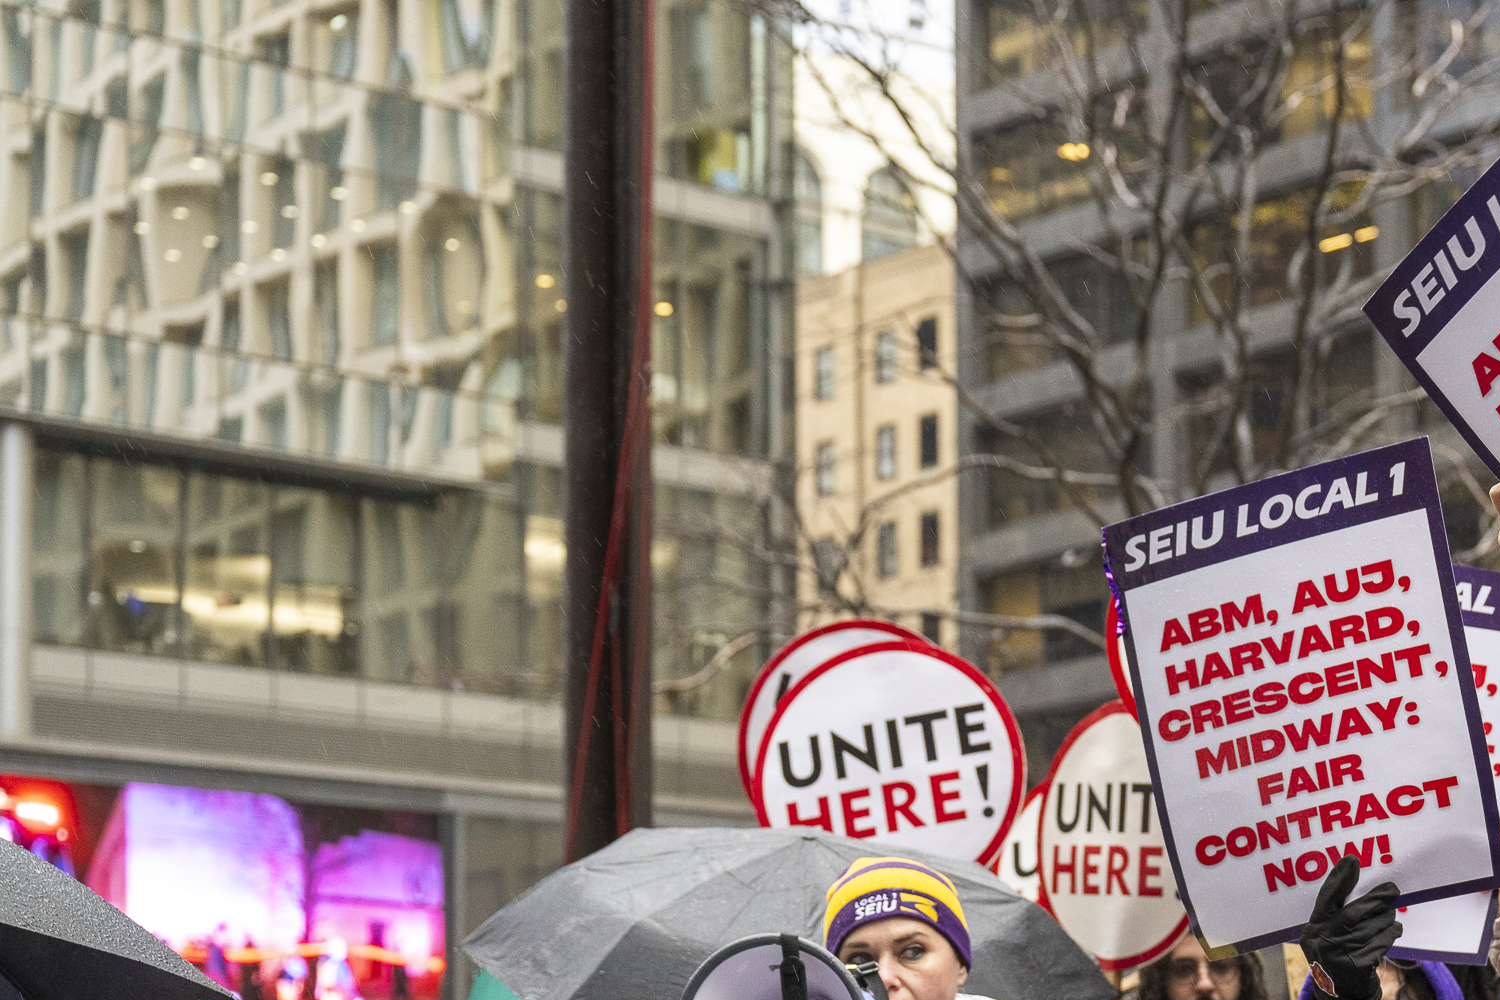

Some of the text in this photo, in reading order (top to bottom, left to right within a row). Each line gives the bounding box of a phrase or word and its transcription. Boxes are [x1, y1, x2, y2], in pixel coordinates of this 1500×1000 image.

[1392, 225, 1487, 337] SEIU
[1124, 461, 1407, 574] SEIU LOCAL 1
[1159, 592, 1278, 653] ABM,
[1290, 558, 1411, 617] AUJ,
[1158, 643, 1448, 743] CRESCENT,
[1164, 605, 1421, 696] HARVARD,
[779, 702, 993, 788] UNITE
[1195, 696, 1421, 781] MIDWAY:
[1257, 754, 1364, 806] FAIR
[786, 764, 995, 840] HERE!
[1056, 782, 1154, 834] UNIT
[1195, 776, 1460, 867] CONTRACT
[854, 892, 898, 909] LOCAL 1
[1052, 844, 1180, 900] HERE
[1262, 833, 1394, 893] NOW!
[854, 899, 898, 921] SEIU
